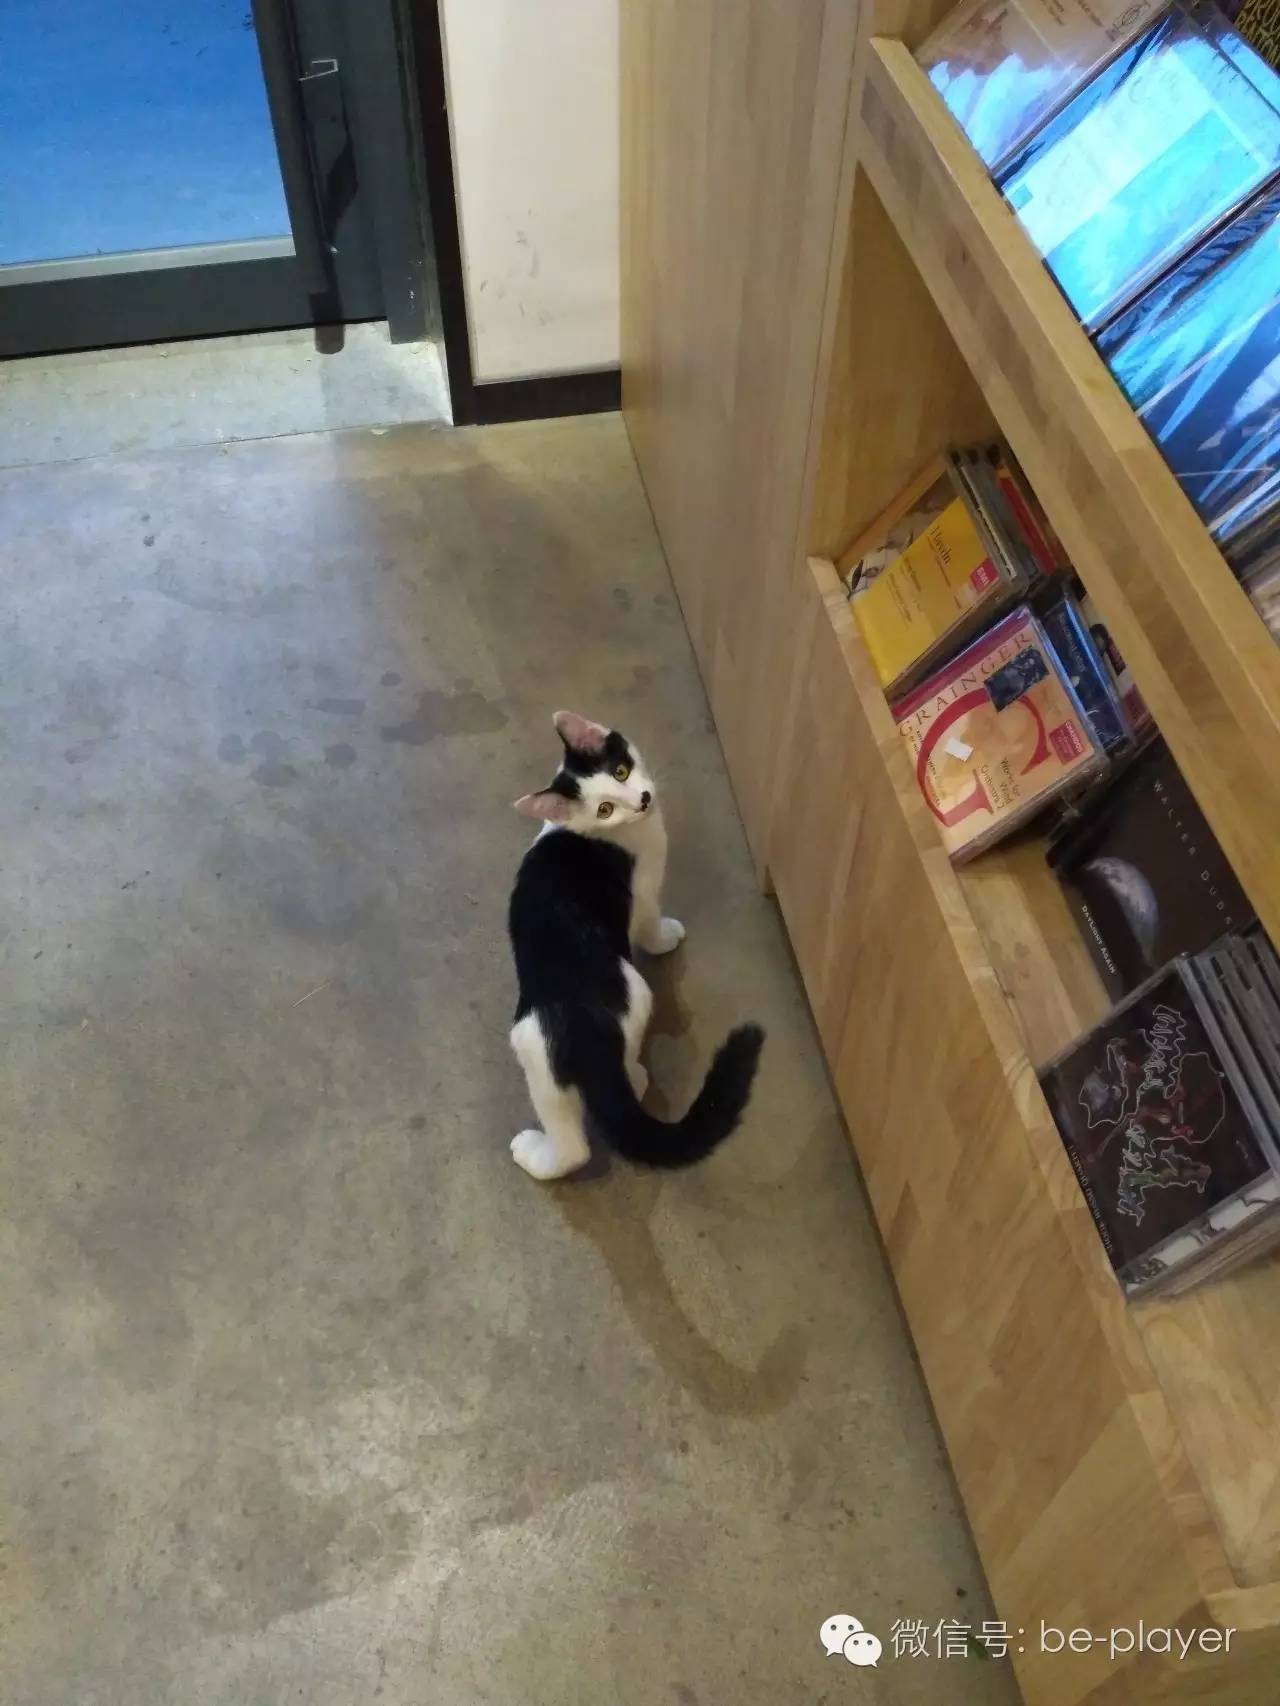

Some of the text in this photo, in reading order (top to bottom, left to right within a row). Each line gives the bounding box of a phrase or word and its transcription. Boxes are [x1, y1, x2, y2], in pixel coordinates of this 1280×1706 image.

[900, 632, 1031, 738] GRAINGER
[1081, 904, 1117, 974] DAYLIGHT AGAIN
